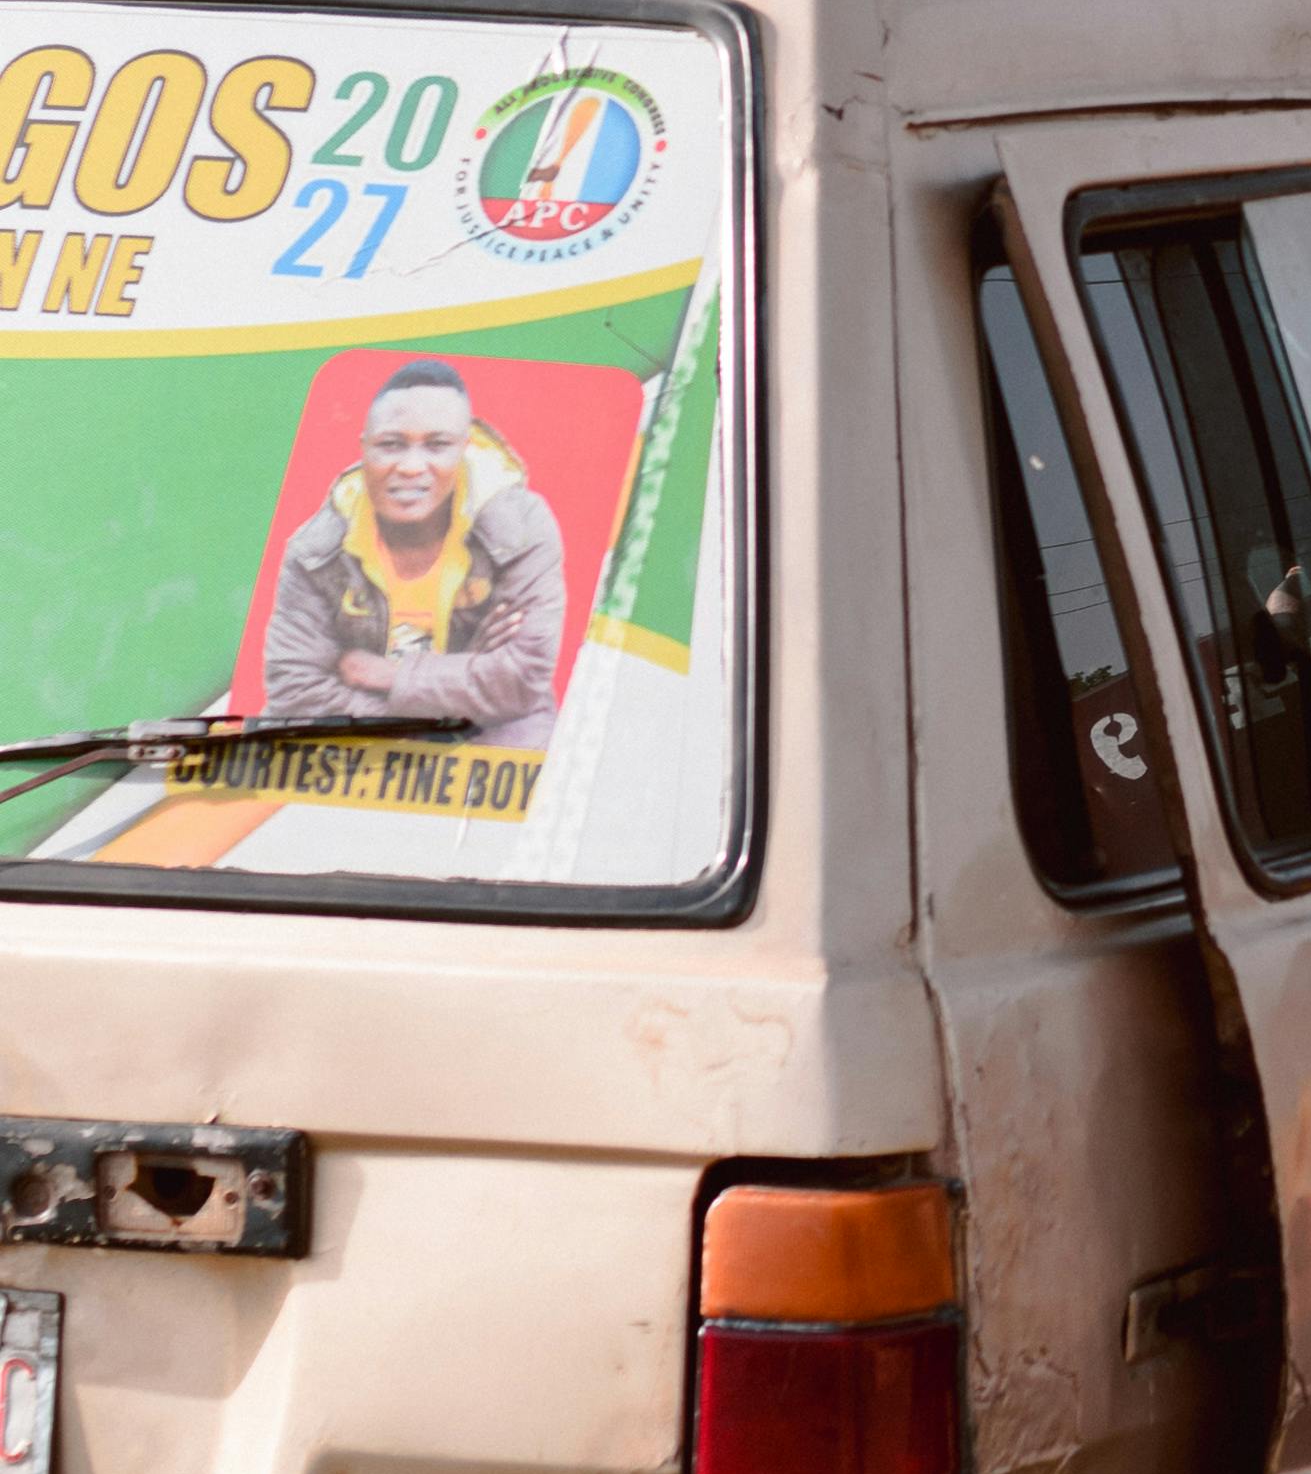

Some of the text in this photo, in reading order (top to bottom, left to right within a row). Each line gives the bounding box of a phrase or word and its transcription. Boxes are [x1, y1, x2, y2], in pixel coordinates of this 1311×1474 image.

[0, 43, 460, 223] GOS 20
[270, 177, 409, 280] 27
[494, 199, 591, 232] APC
[42, 230, 155, 318] NE
[376, 750, 458, 806] FINE
[464, 757, 543, 812] BOY
